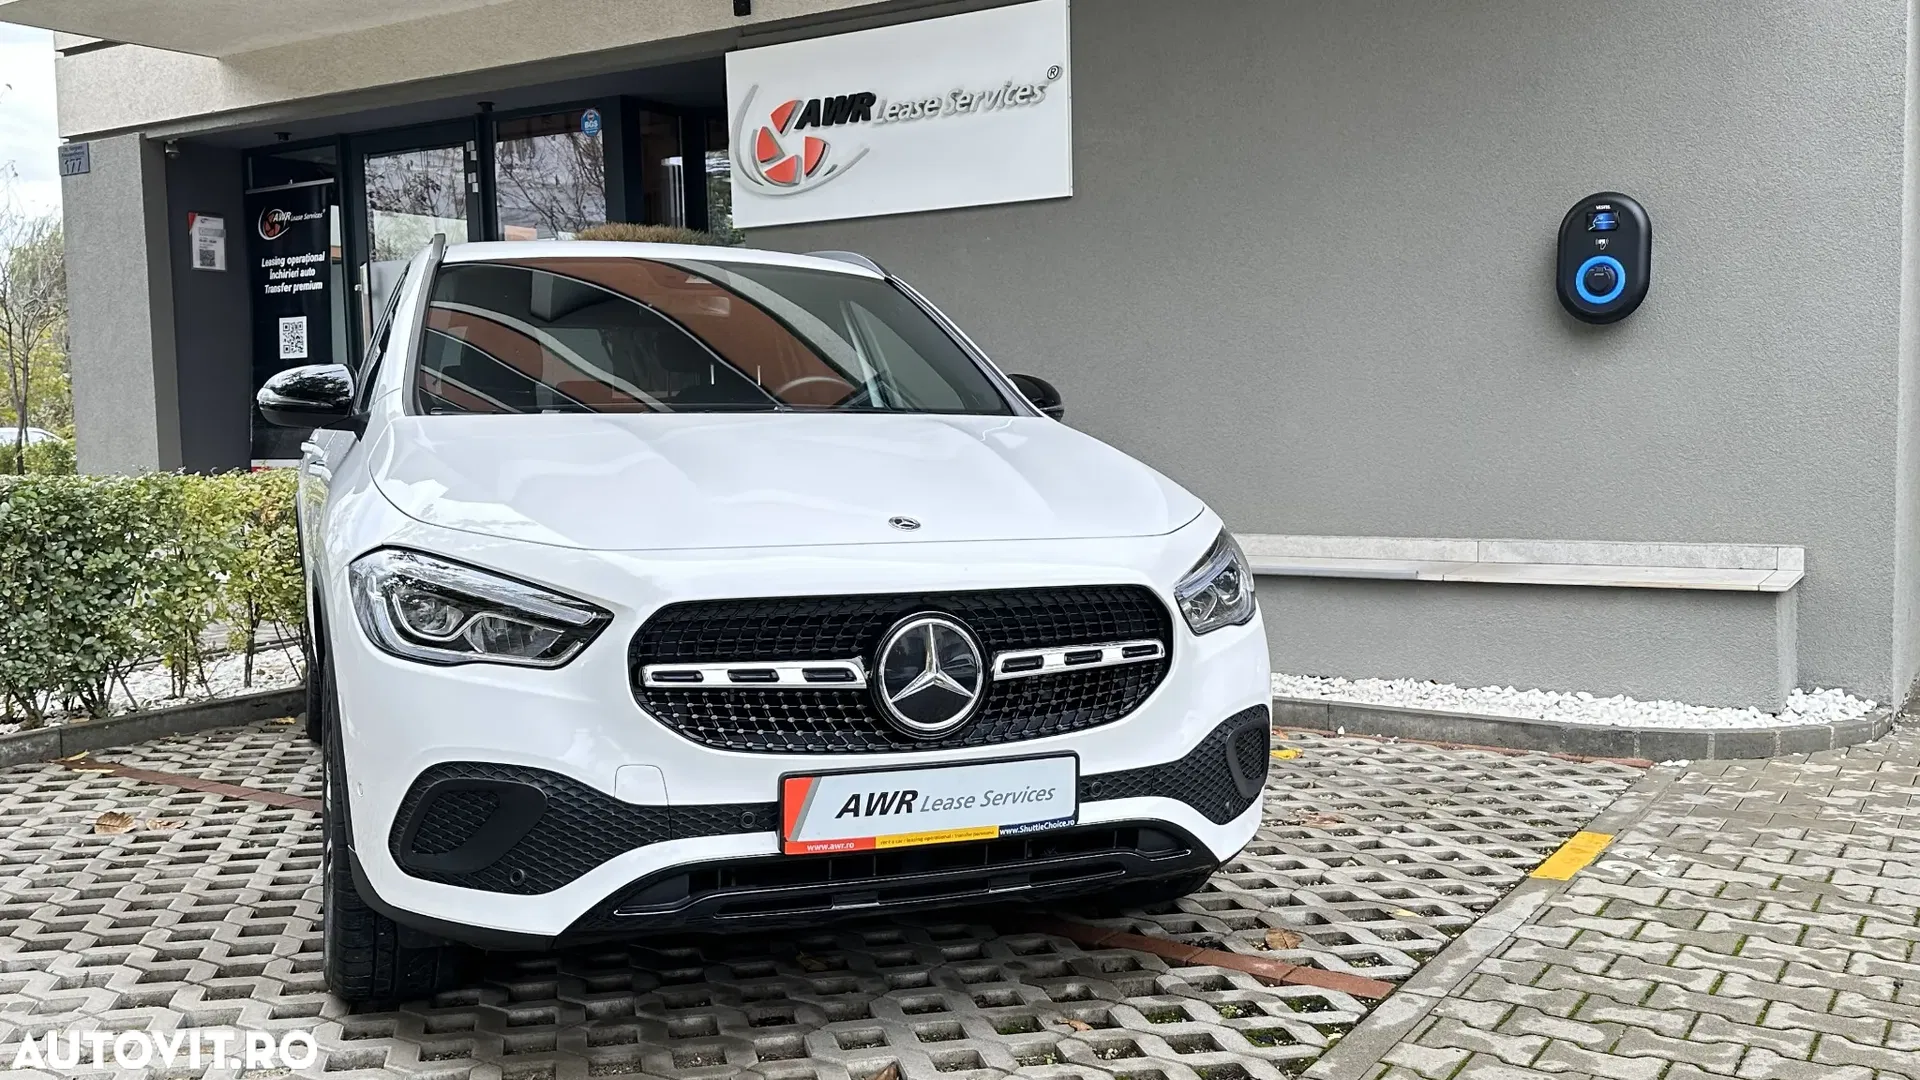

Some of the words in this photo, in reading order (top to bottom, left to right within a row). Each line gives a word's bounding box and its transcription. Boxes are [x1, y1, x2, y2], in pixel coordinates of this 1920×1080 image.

[794, 91, 877, 131] AWR
[874, 96, 943, 124] Lease
[942, 79, 1049, 118] Services
[584, 120, 598, 129] BGS
[64, 157, 82, 174] 177
[272, 211, 292, 222] AWR
[303, 212, 323, 220] Services
[261, 255, 285, 268] Leasing
[300, 267, 316, 277] auto
[264, 282, 292, 294] Transfer
[292, 280, 323, 294] premium
[835, 789, 919, 820] AWR
[919, 794, 976, 813] Lease
[980, 785, 1057, 809] Services
[999, 818, 1076, 836] www.ShuttleChoice.ro
[806, 841, 856, 852] www.awr.ro
